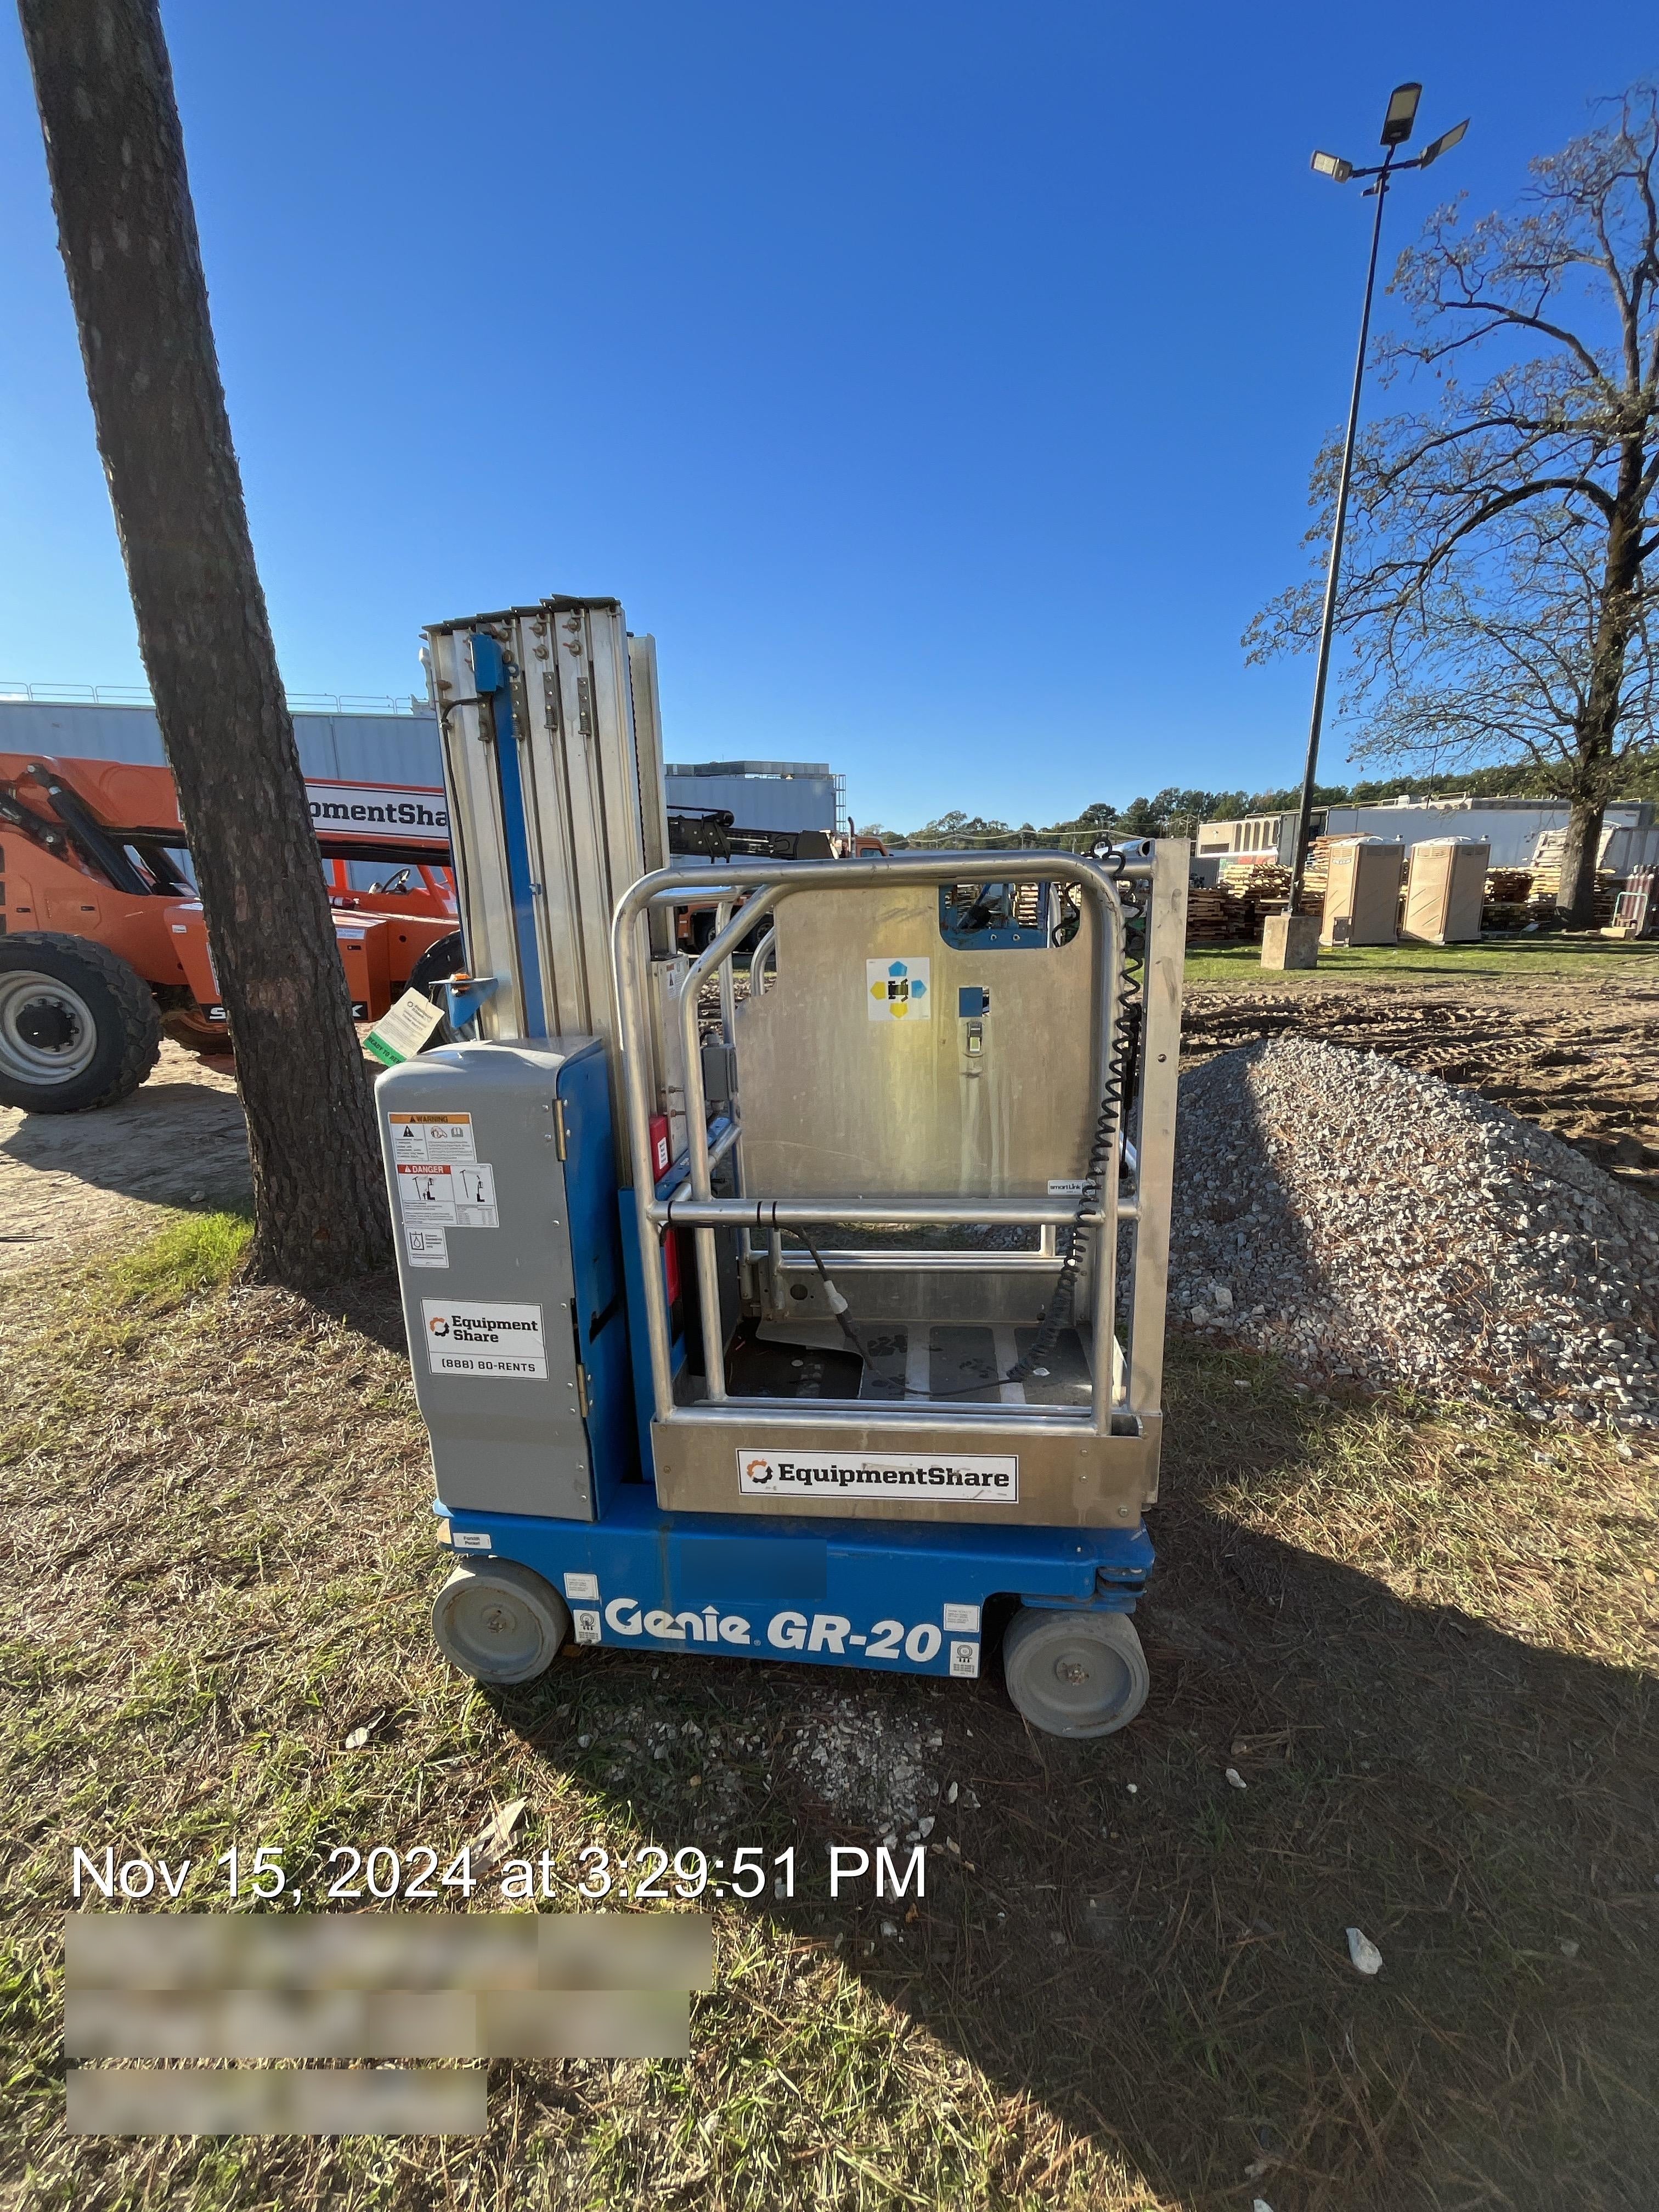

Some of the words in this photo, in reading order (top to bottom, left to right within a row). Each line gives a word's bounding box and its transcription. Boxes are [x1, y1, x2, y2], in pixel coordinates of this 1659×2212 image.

[308, 801, 447, 826] pmentSha
[367, 1036, 383, 1051] READY
[390, 1056, 402, 1064] REN
[412, 1165, 444, 1173] DANGER
[451, 1316, 538, 1331] Equipment
[453, 1329, 499, 1342] Share
[442, 1358, 474, 1369] (888)
[478, 1361, 535, 1372] 80-RENTS
[778, 1463, 1010, 1487] EquipmentShare
[605, 1598, 751, 1645] Genie
[767, 1611, 942, 1662] GR-20
